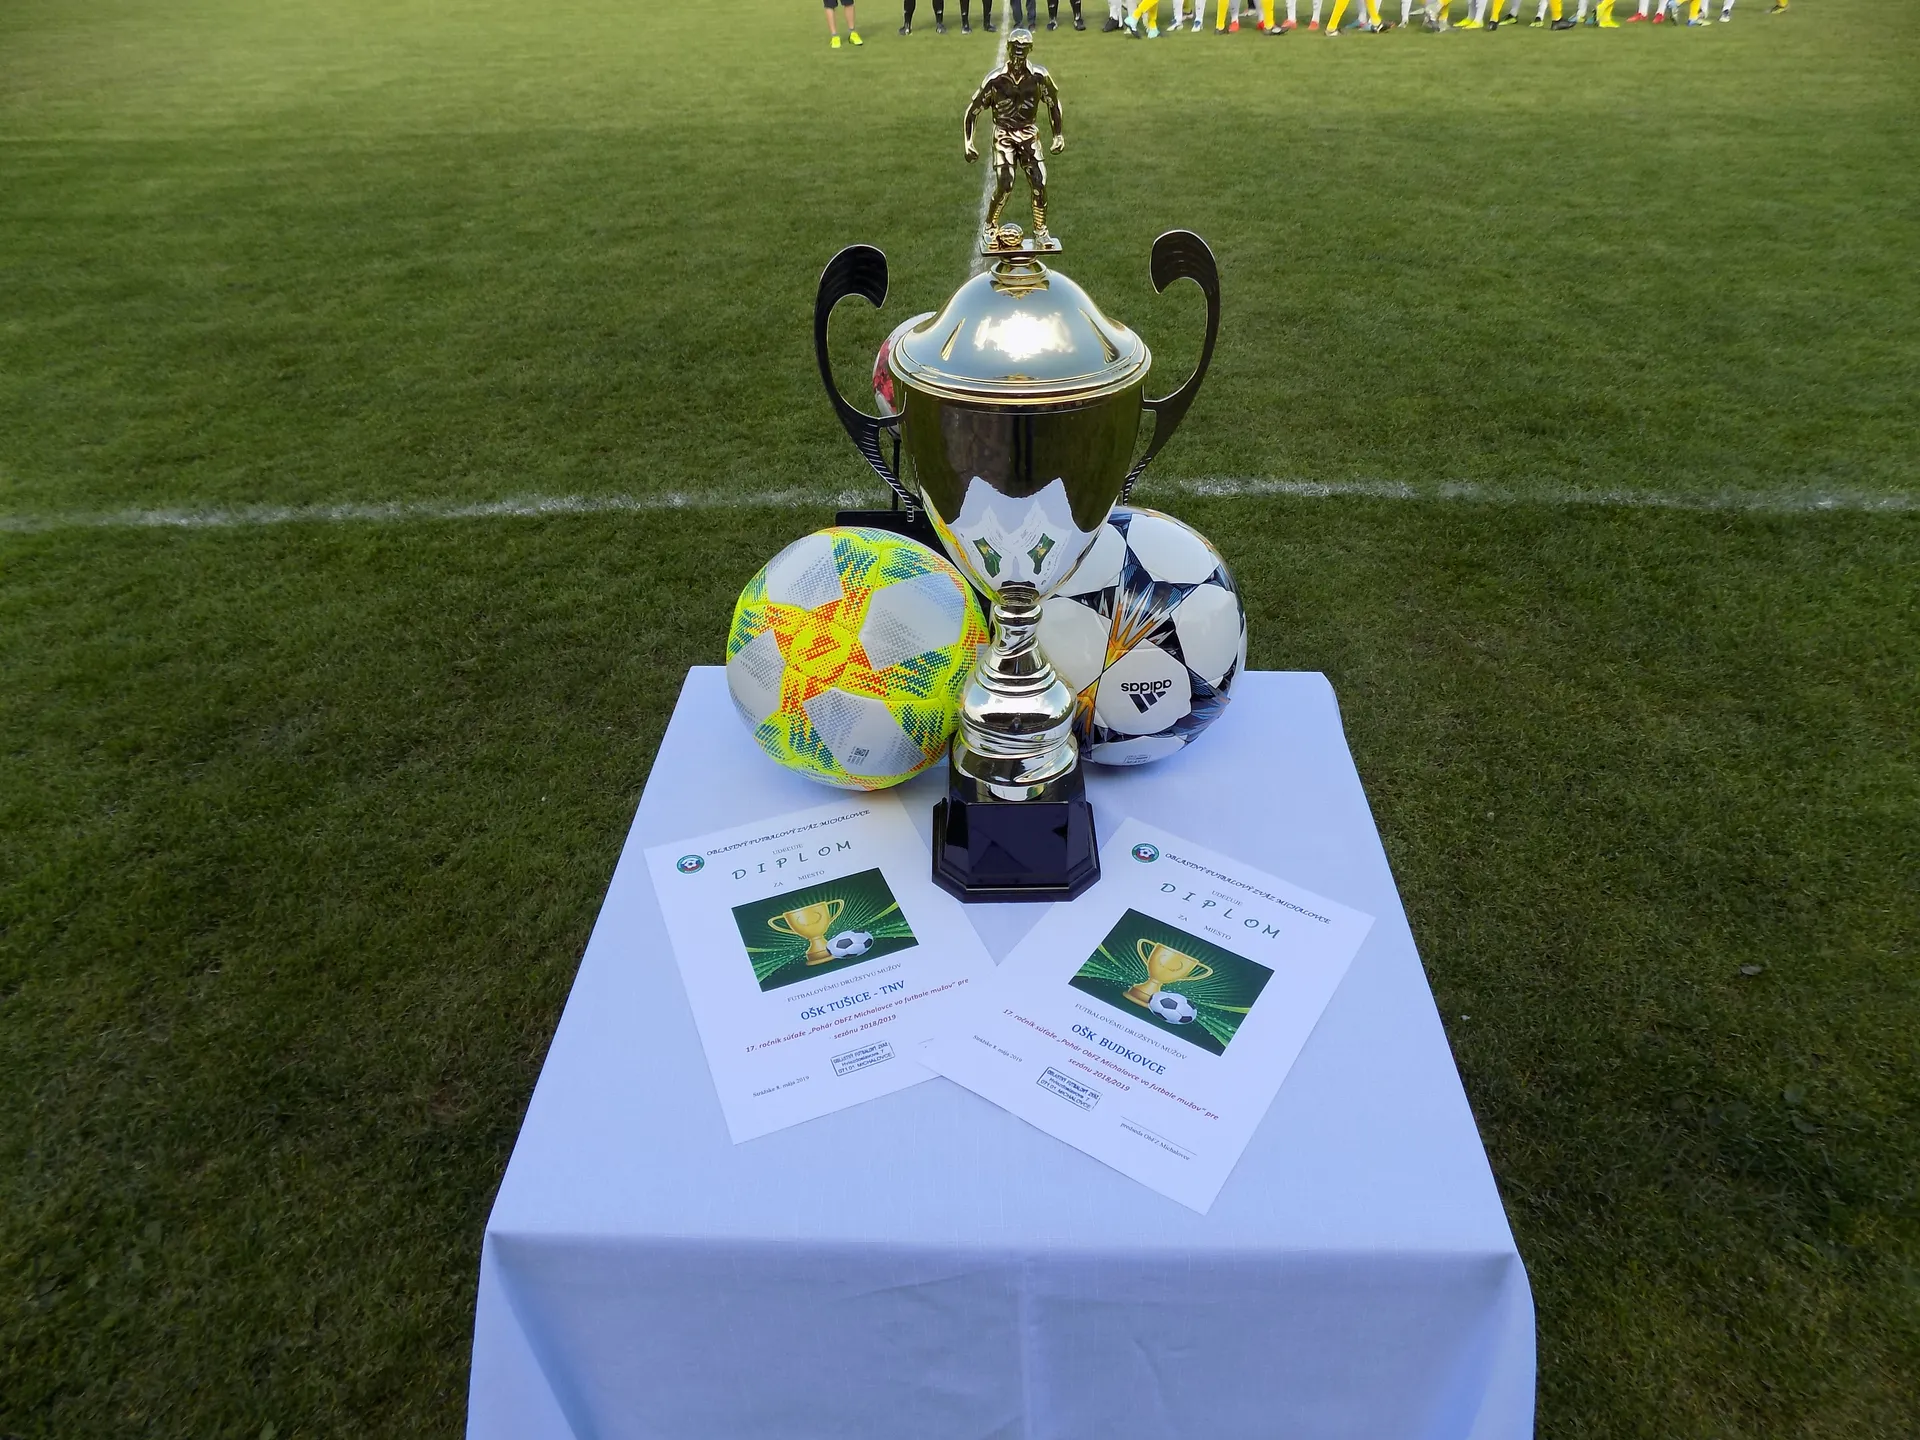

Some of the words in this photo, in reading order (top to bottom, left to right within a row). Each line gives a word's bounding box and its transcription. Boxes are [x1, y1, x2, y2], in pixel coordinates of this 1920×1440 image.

[1121, 679, 1172, 694] adidas
[819, 810, 870, 827] MICHALOVCE
[798, 870, 824, 881] MIESTO
[1276, 899, 1331, 924] MICHALOVCE
[1204, 925, 1231, 940] MIESTO
[787, 982, 839, 1002] FUTBALOVÉMU
[840, 971, 876, 987] DRUŽSTVU
[877, 963, 901, 975] MUŽOV
[746, 1045, 757, 1053] 17.
[759, 1037, 781, 1049] ročník
[783, 1030, 806, 1042] súťaže
[834, 1015, 852, 1026] ObFZ
[854, 1002, 892, 1020] Michalovce
[894, 999, 903, 1007] vo
[903, 990, 928, 1004] futbale
[958, 978, 969, 990] pre
[801, 1005, 826, 1020] OŠK
[827, 990, 871, 1012] TUŠICE
[879, 980, 904, 995] TNV
[834, 1028, 858, 1039] sezónu
[860, 1014, 896, 1031] 2018/2019
[1075, 1003, 1124, 1031] FUTBALOVÉMU
[1124, 1025, 1161, 1048] DRUŽSTVU
[1162, 1043, 1187, 1059] MUŽOV
[1003, 1008, 1013, 1017] 17.
[1014, 1014, 1035, 1028] ročník
[1036, 1025, 1057, 1039] súťaže
[1082, 1049, 1100, 1062] ObFZ
[1100, 1058, 1139, 1082] Michalovce
[1141, 1078, 1149, 1086] vo
[1149, 1083, 1176, 1100] futbale
[1204, 1109, 1219, 1121] pre
[1010, 1053, 1022, 1063] 2019
[1072, 1024, 1097, 1042] OŠK
[1099, 1037, 1166, 1075] BUDKOVCE
[1068, 1058, 1092, 1074] sezónu
[1093, 1071, 1130, 1092] 2018/2019
[1120, 1121, 1143, 1137] predseda
[1160, 1142, 1190, 1161] Michalovce
